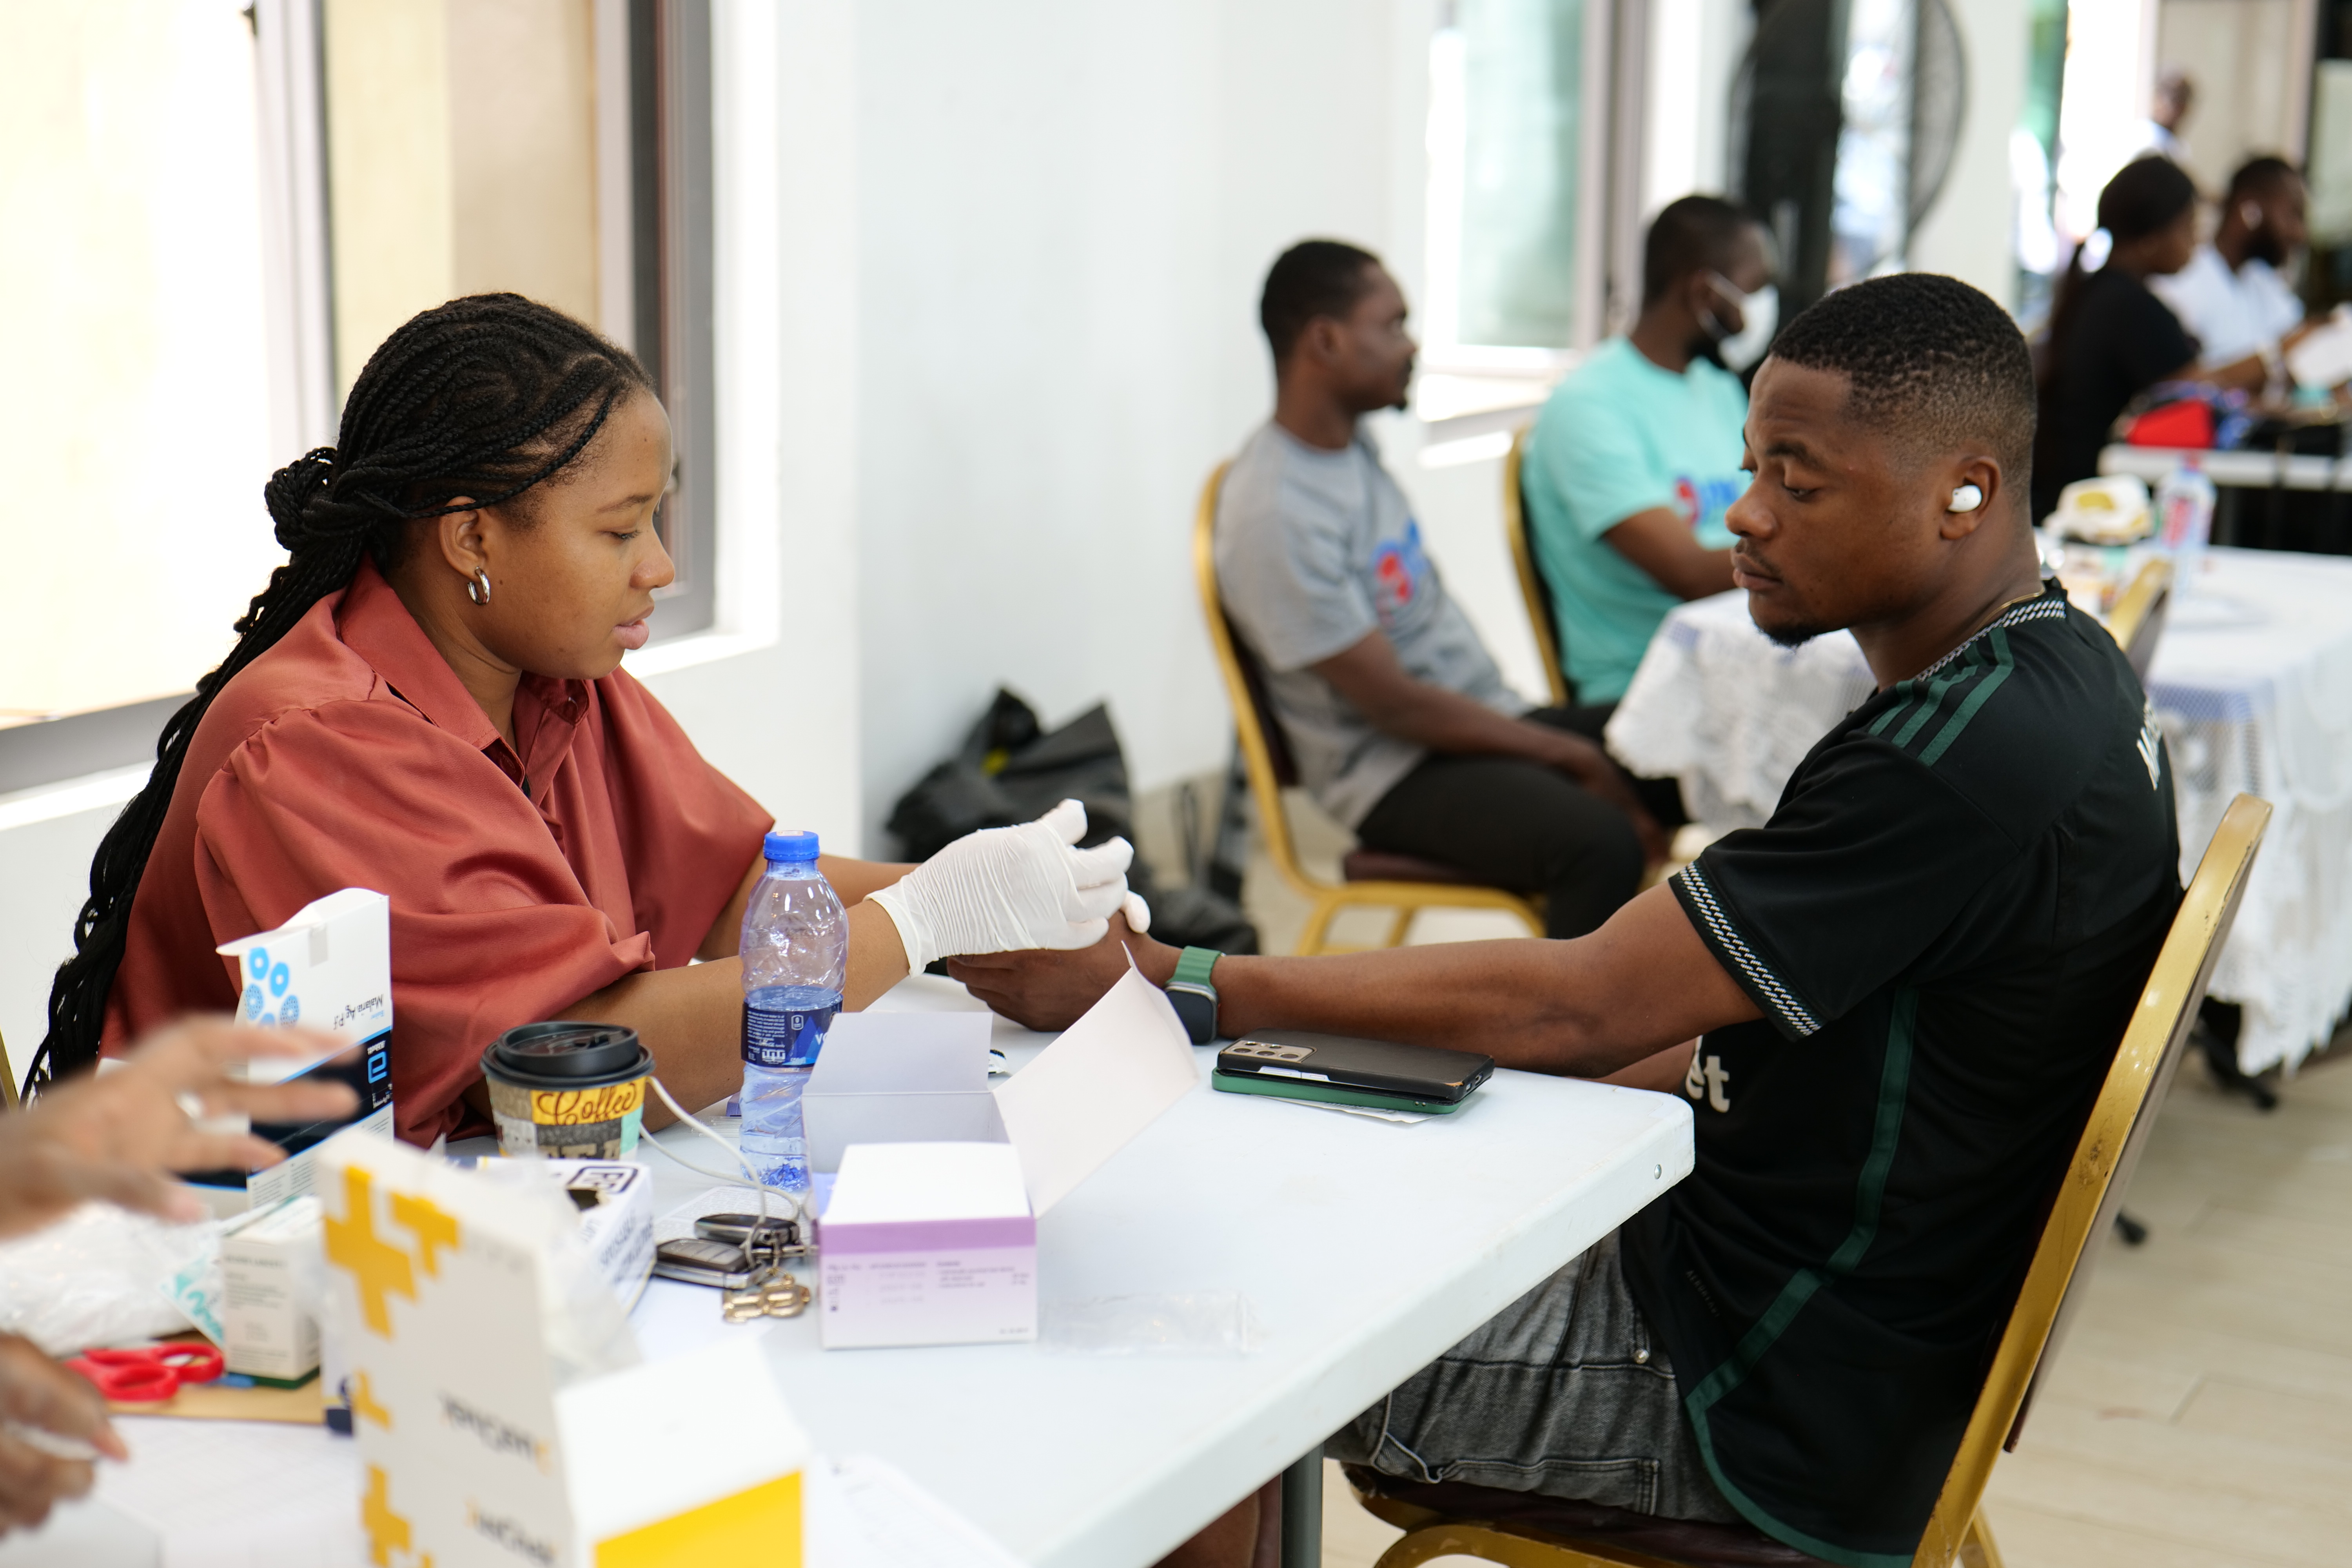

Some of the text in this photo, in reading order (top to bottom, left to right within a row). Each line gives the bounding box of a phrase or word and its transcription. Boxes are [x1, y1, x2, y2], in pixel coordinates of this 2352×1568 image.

[345, 1005, 356, 1020] Ag
[357, 994, 384, 1015] Malaria
[367, 1040, 386, 1055] Abbott
[537, 1082, 637, 1125] Coffee
